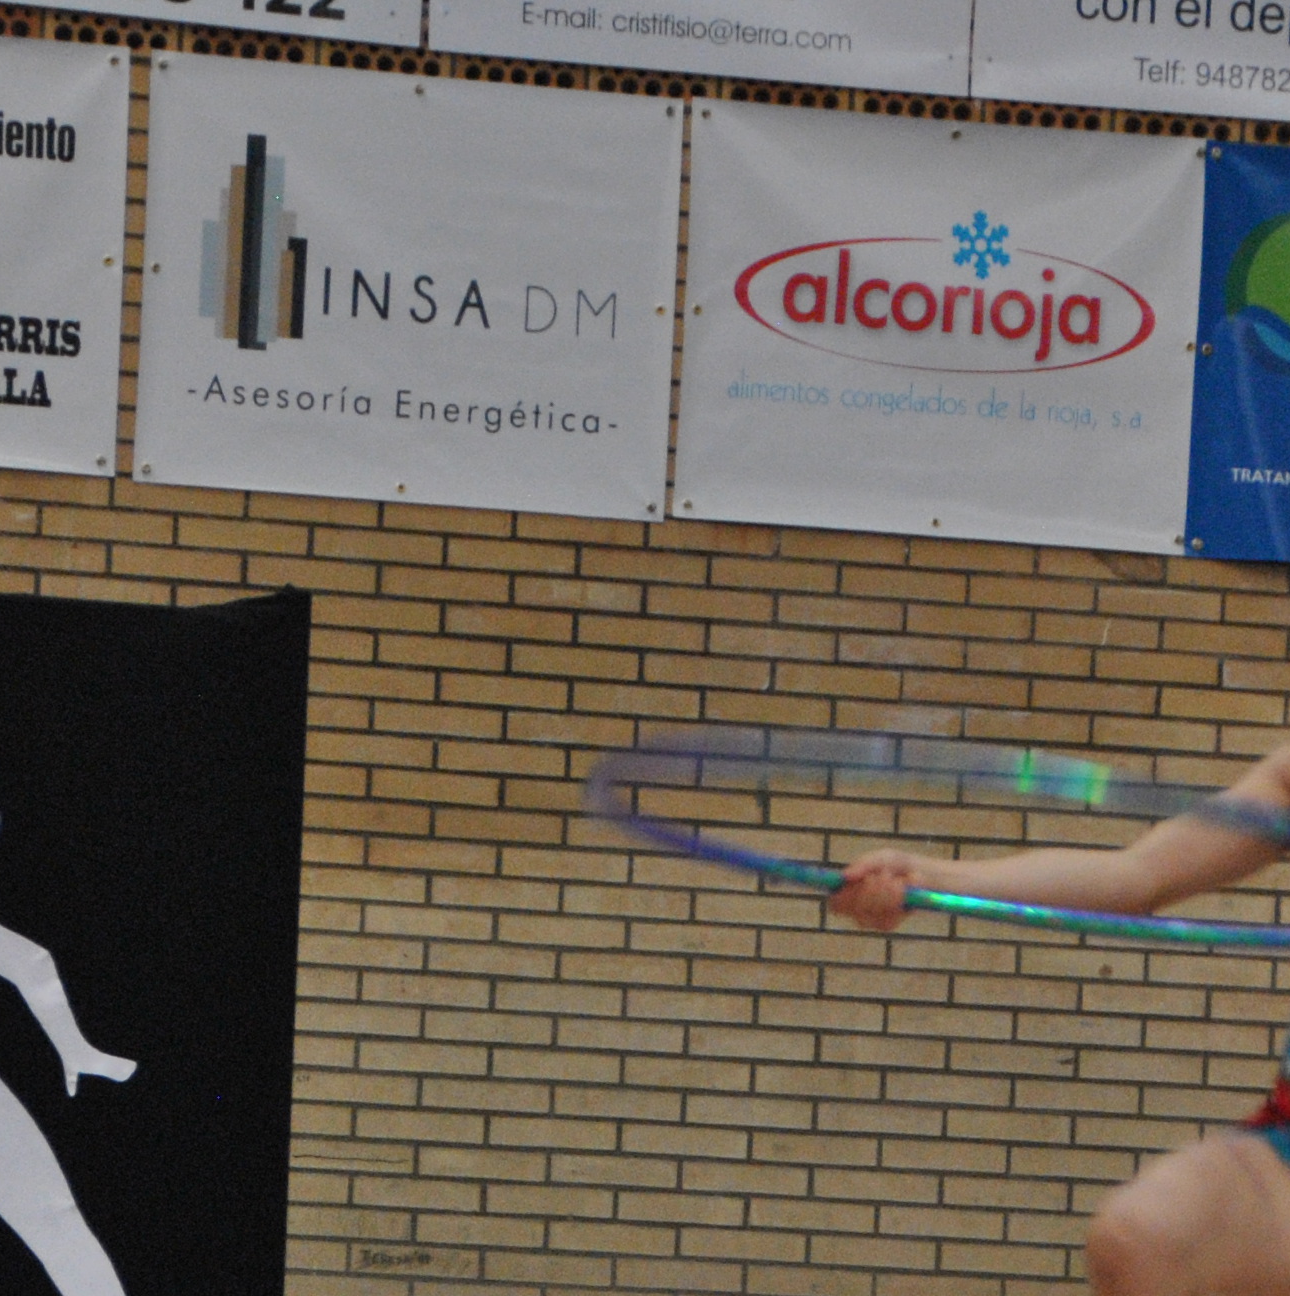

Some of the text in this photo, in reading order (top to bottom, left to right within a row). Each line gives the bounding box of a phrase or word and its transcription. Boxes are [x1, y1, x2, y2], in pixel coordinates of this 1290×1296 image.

[521, 2, 853, 51] E-mail: cristifisio@terra.com
[1133, 57, 1186, 85] Telf:
[322, 266, 617, 339] INSA DM
[782, 248, 1101, 361] alcorioja
[727, 368, 830, 405] alimentos
[839, 382, 966, 416] congelados
[977, 387, 1009, 420] de
[1020, 389, 1036, 421] la
